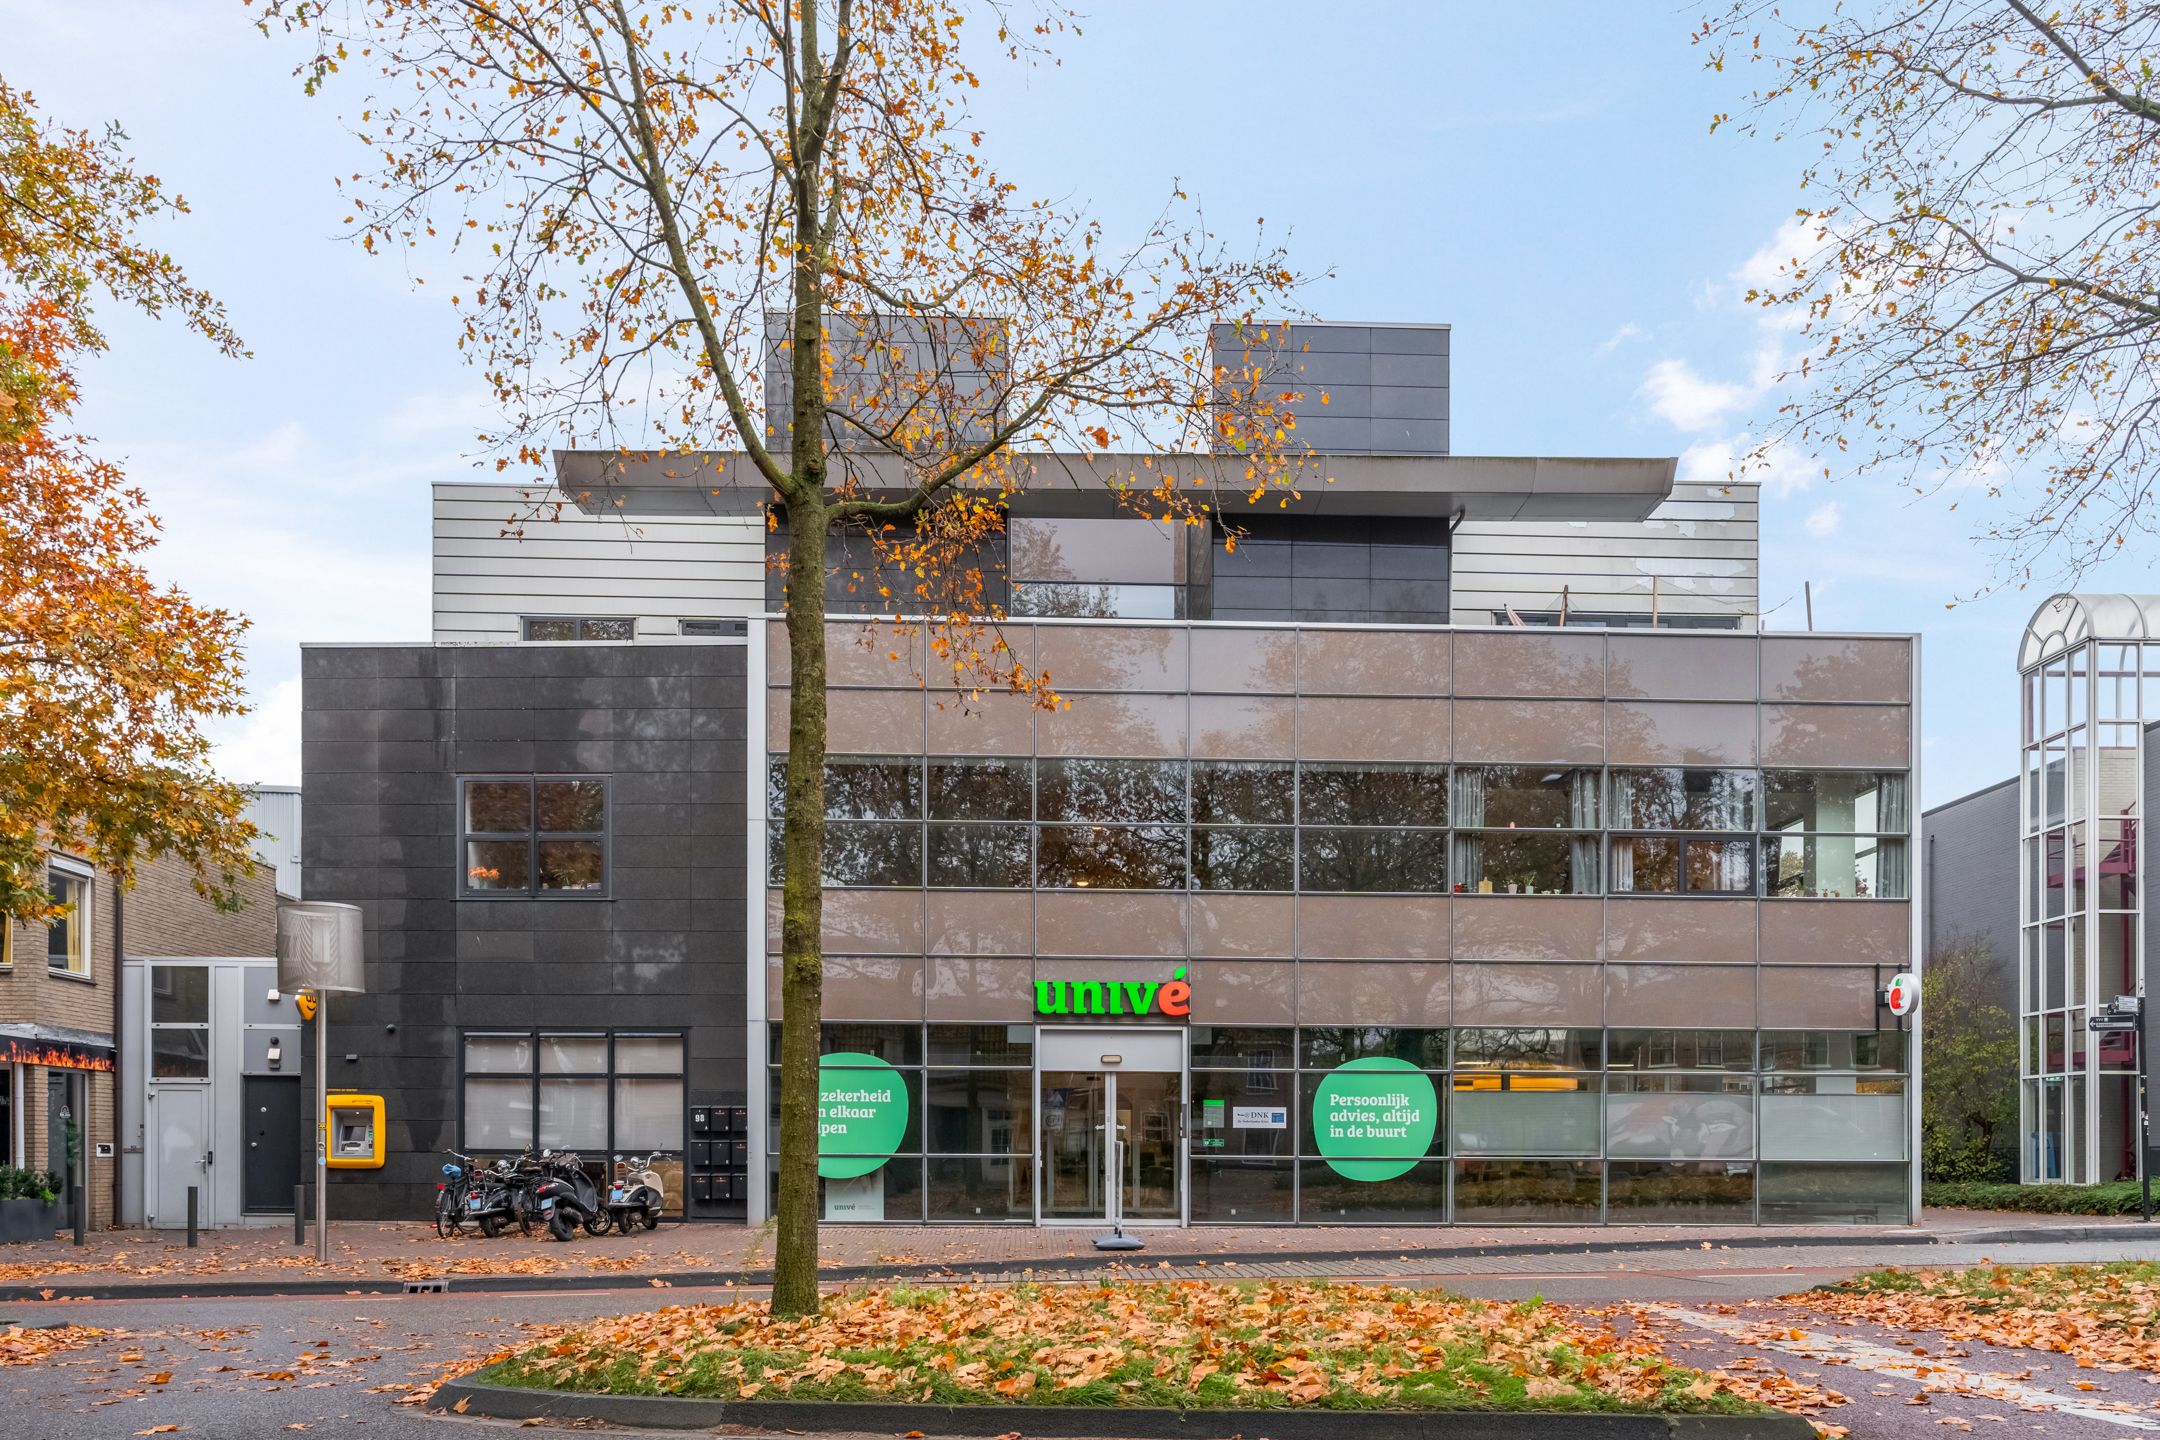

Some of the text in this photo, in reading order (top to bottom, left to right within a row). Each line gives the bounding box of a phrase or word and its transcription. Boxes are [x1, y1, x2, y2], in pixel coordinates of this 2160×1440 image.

[1034, 966, 1191, 1016] univé
[821, 1089, 891, 1102] zekerheid
[1329, 1093, 1410, 1109] Persoonlijk
[829, 1105, 876, 1118] elkaar
[1329, 1109, 1420, 1125] advies, altijd
[818, 1121, 847, 1137] lpen
[1329, 1125, 1407, 1138] in de buurt
